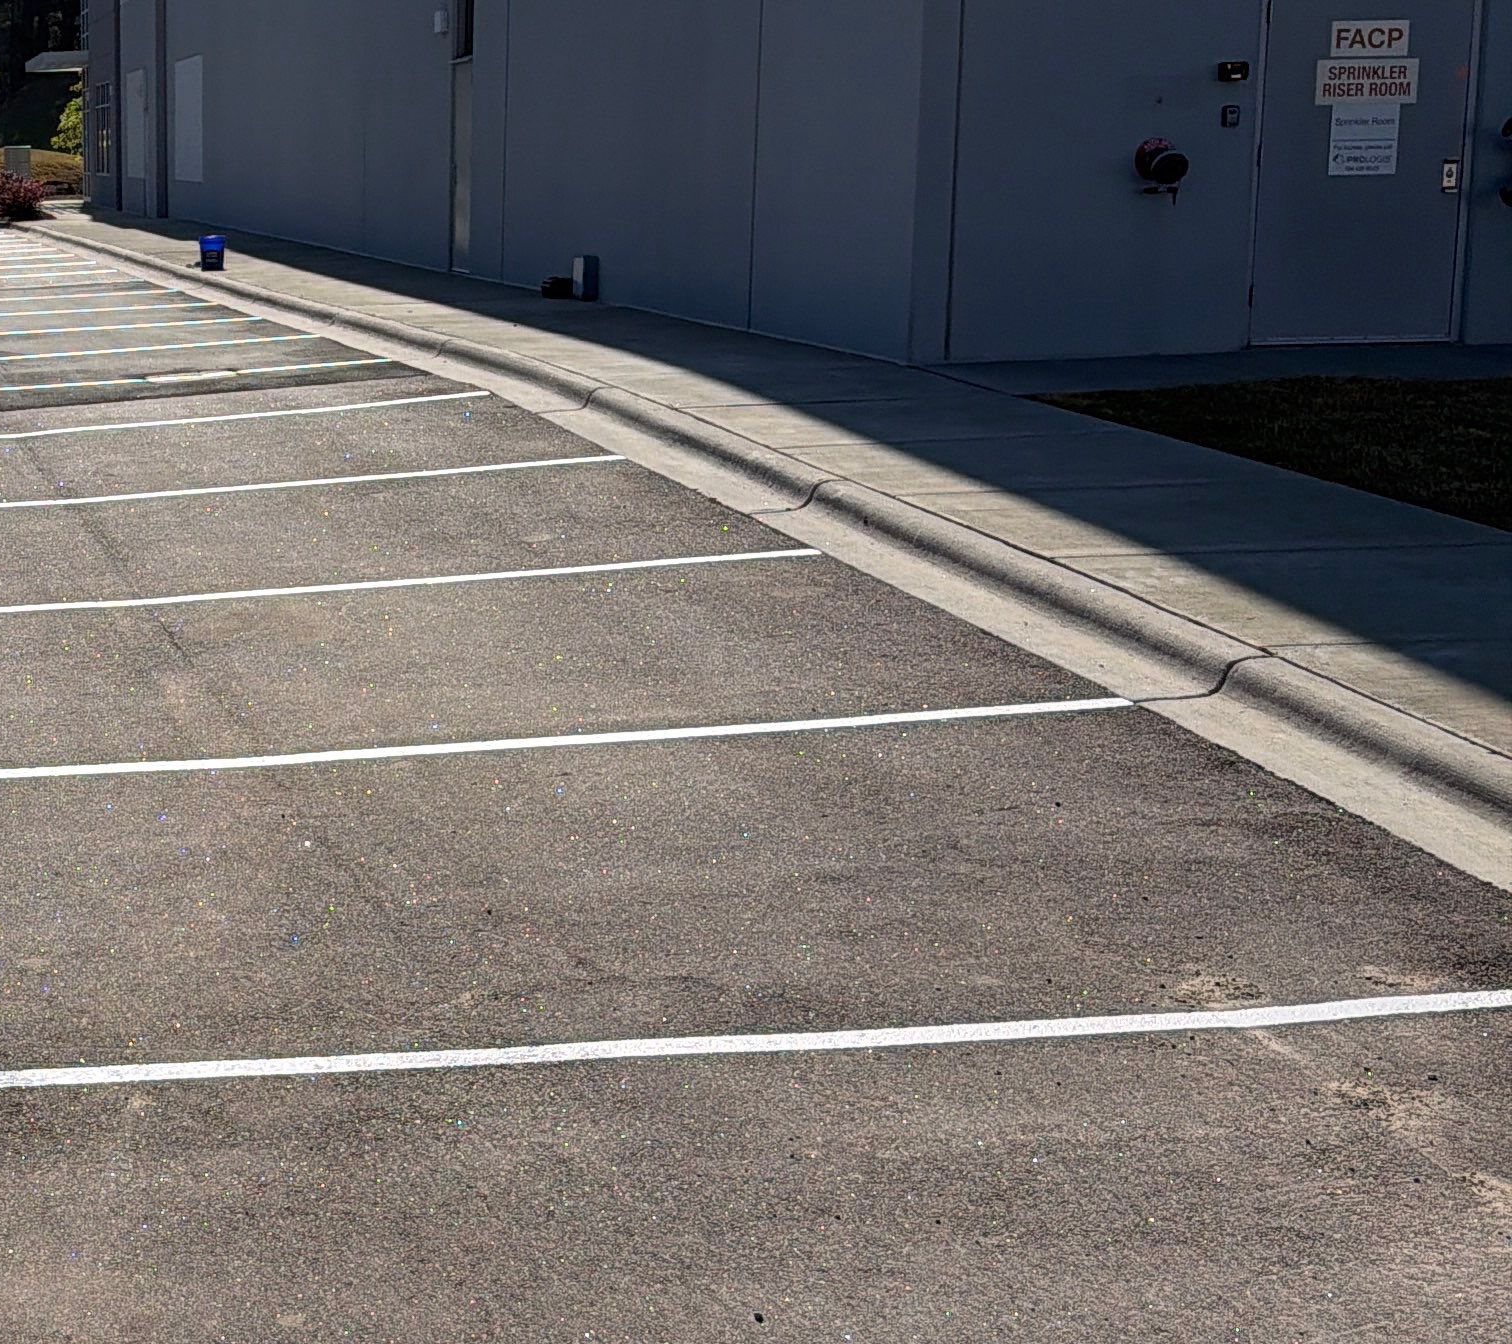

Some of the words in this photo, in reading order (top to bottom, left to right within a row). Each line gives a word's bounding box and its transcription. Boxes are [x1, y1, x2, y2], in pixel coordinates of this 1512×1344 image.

[1335, 27, 1404, 49] FACP
[1327, 65, 1408, 81] SPRINKLER
[1322, 82, 1365, 98] RISER
[1368, 81, 1411, 97] ROOM
